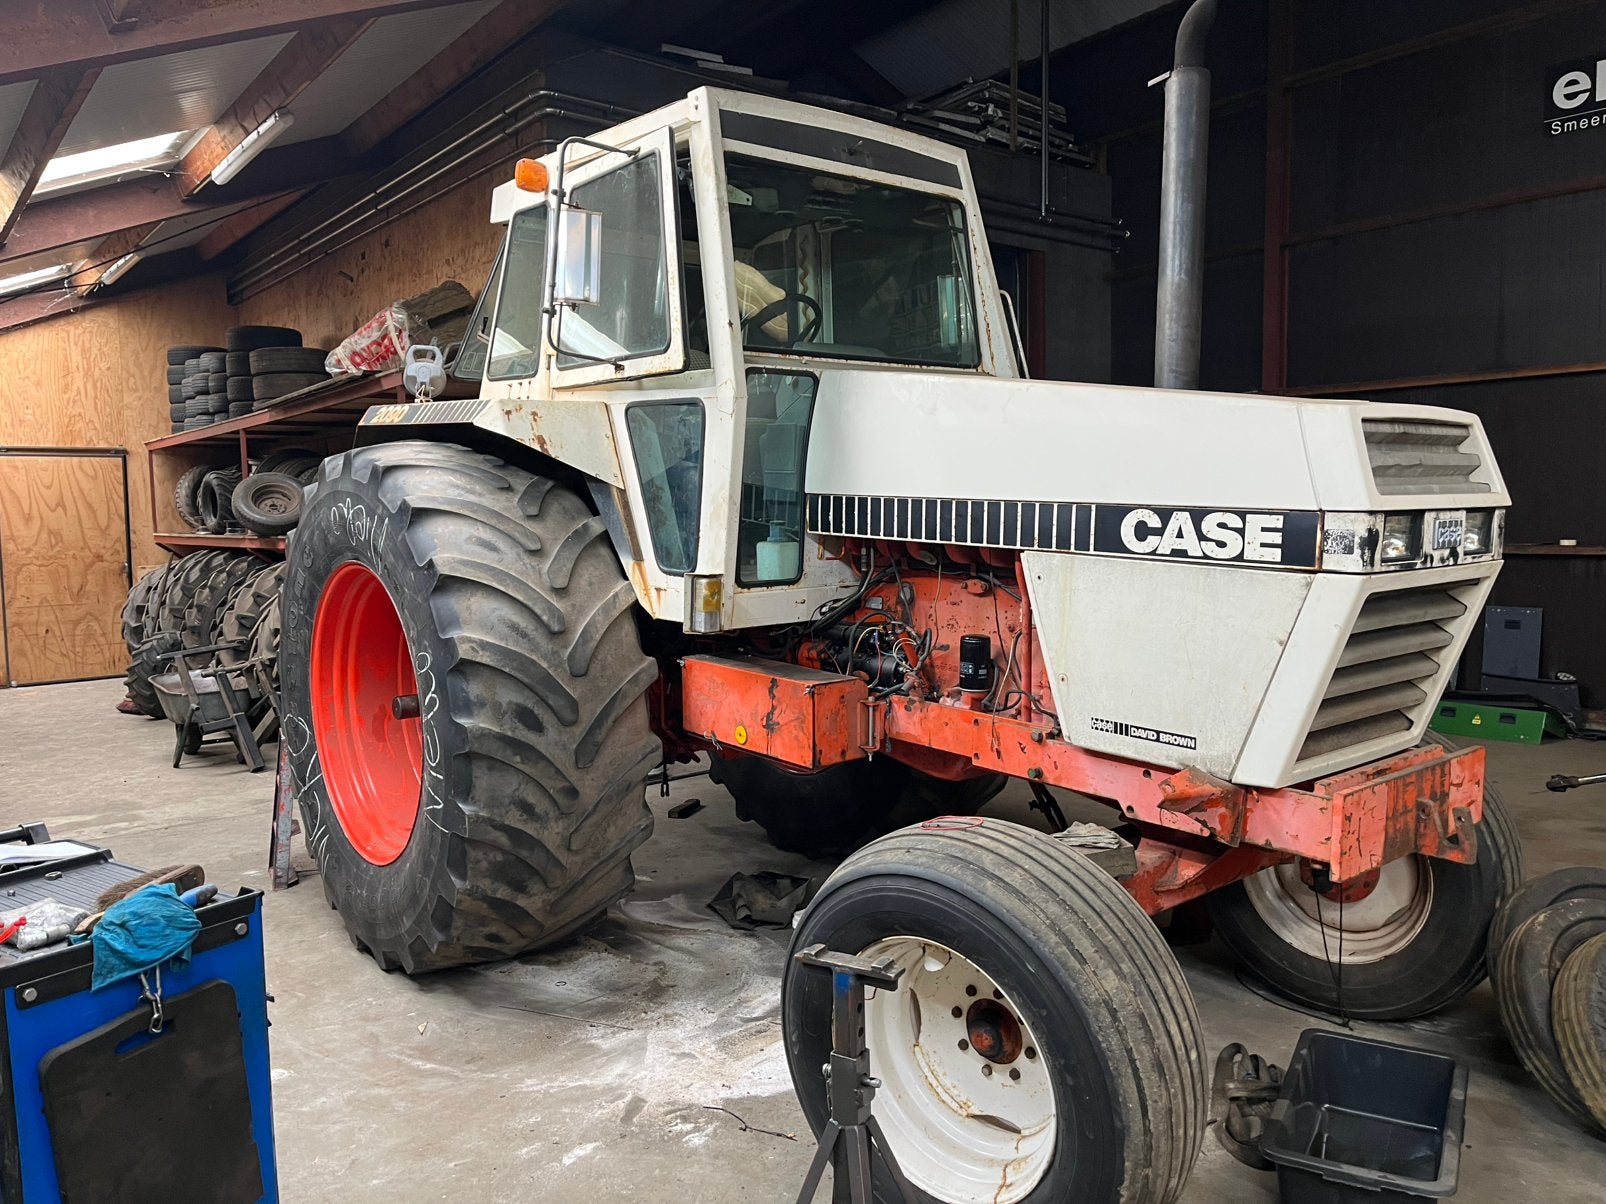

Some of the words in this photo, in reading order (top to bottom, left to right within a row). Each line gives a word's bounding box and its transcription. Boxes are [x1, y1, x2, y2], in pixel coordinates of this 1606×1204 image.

[1120, 508, 1284, 563] CASE
[1130, 727, 1157, 740] DAVID
[1159, 732, 1195, 749] BROWN
